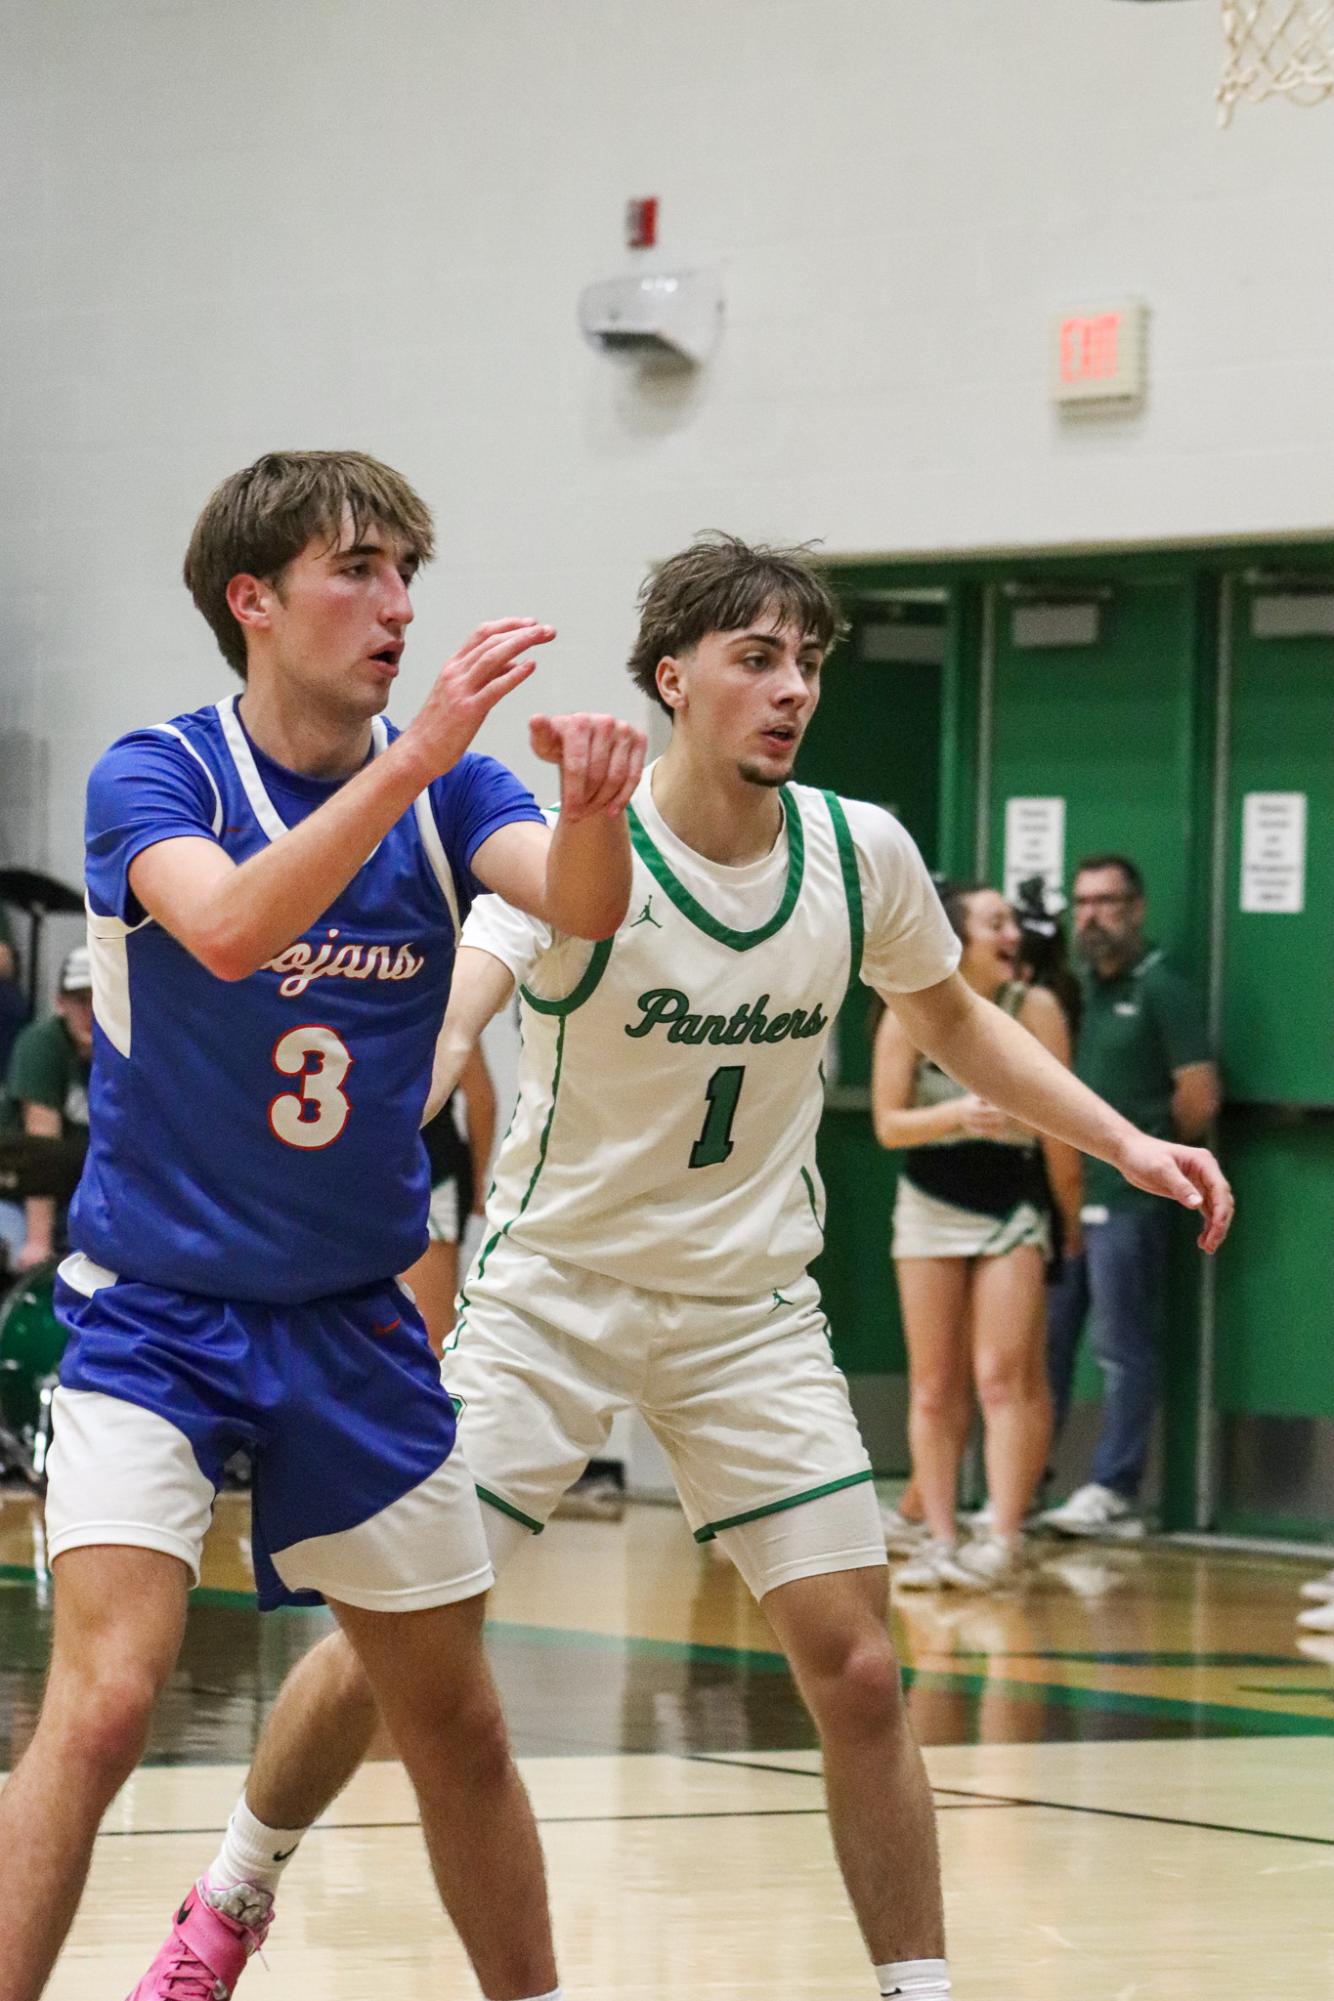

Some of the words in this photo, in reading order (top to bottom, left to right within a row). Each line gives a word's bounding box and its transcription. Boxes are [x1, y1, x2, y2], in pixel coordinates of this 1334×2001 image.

[260, 928, 425, 998] ojans
[624, 988, 828, 1045] Panthers
[267, 1023, 354, 1150] 3
[688, 1065, 746, 1168] 1
